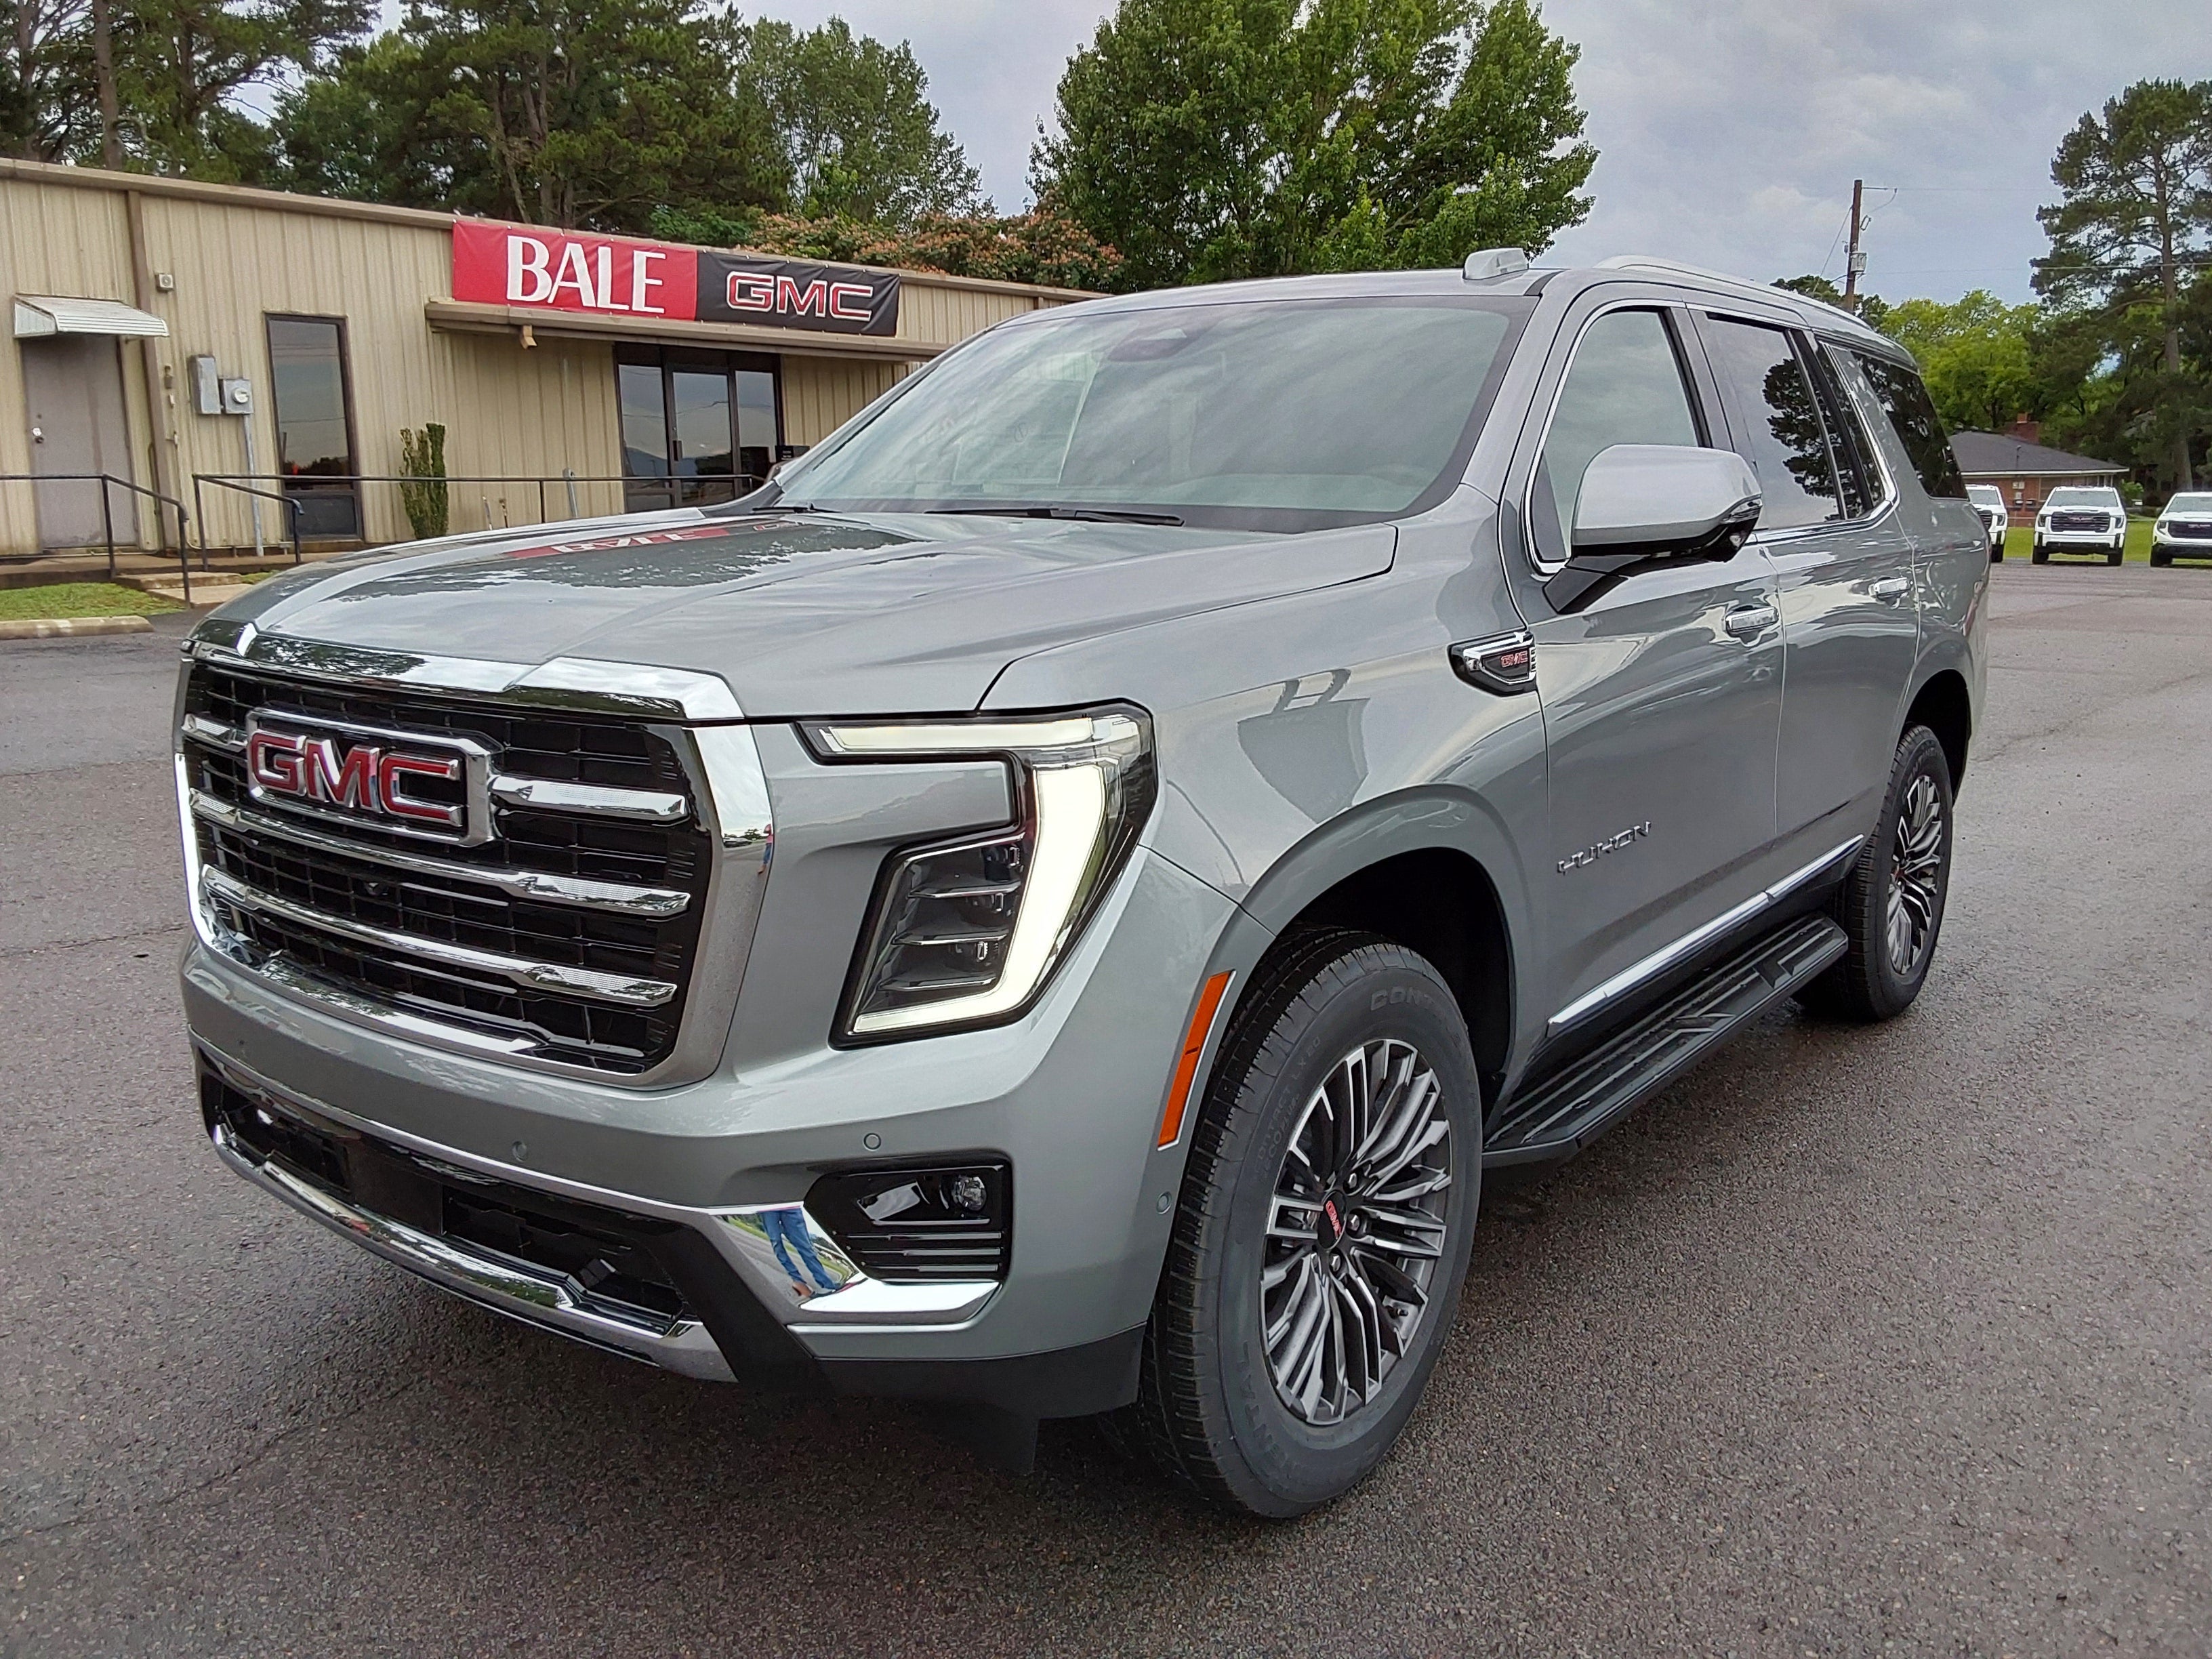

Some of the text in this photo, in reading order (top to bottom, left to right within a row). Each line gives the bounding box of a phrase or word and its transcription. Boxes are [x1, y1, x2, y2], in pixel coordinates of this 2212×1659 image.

[506, 234, 666, 314] BALE
[726, 270, 874, 322] GMC
[1500, 651, 1528, 668] GMC
[251, 729, 463, 827] GMC
